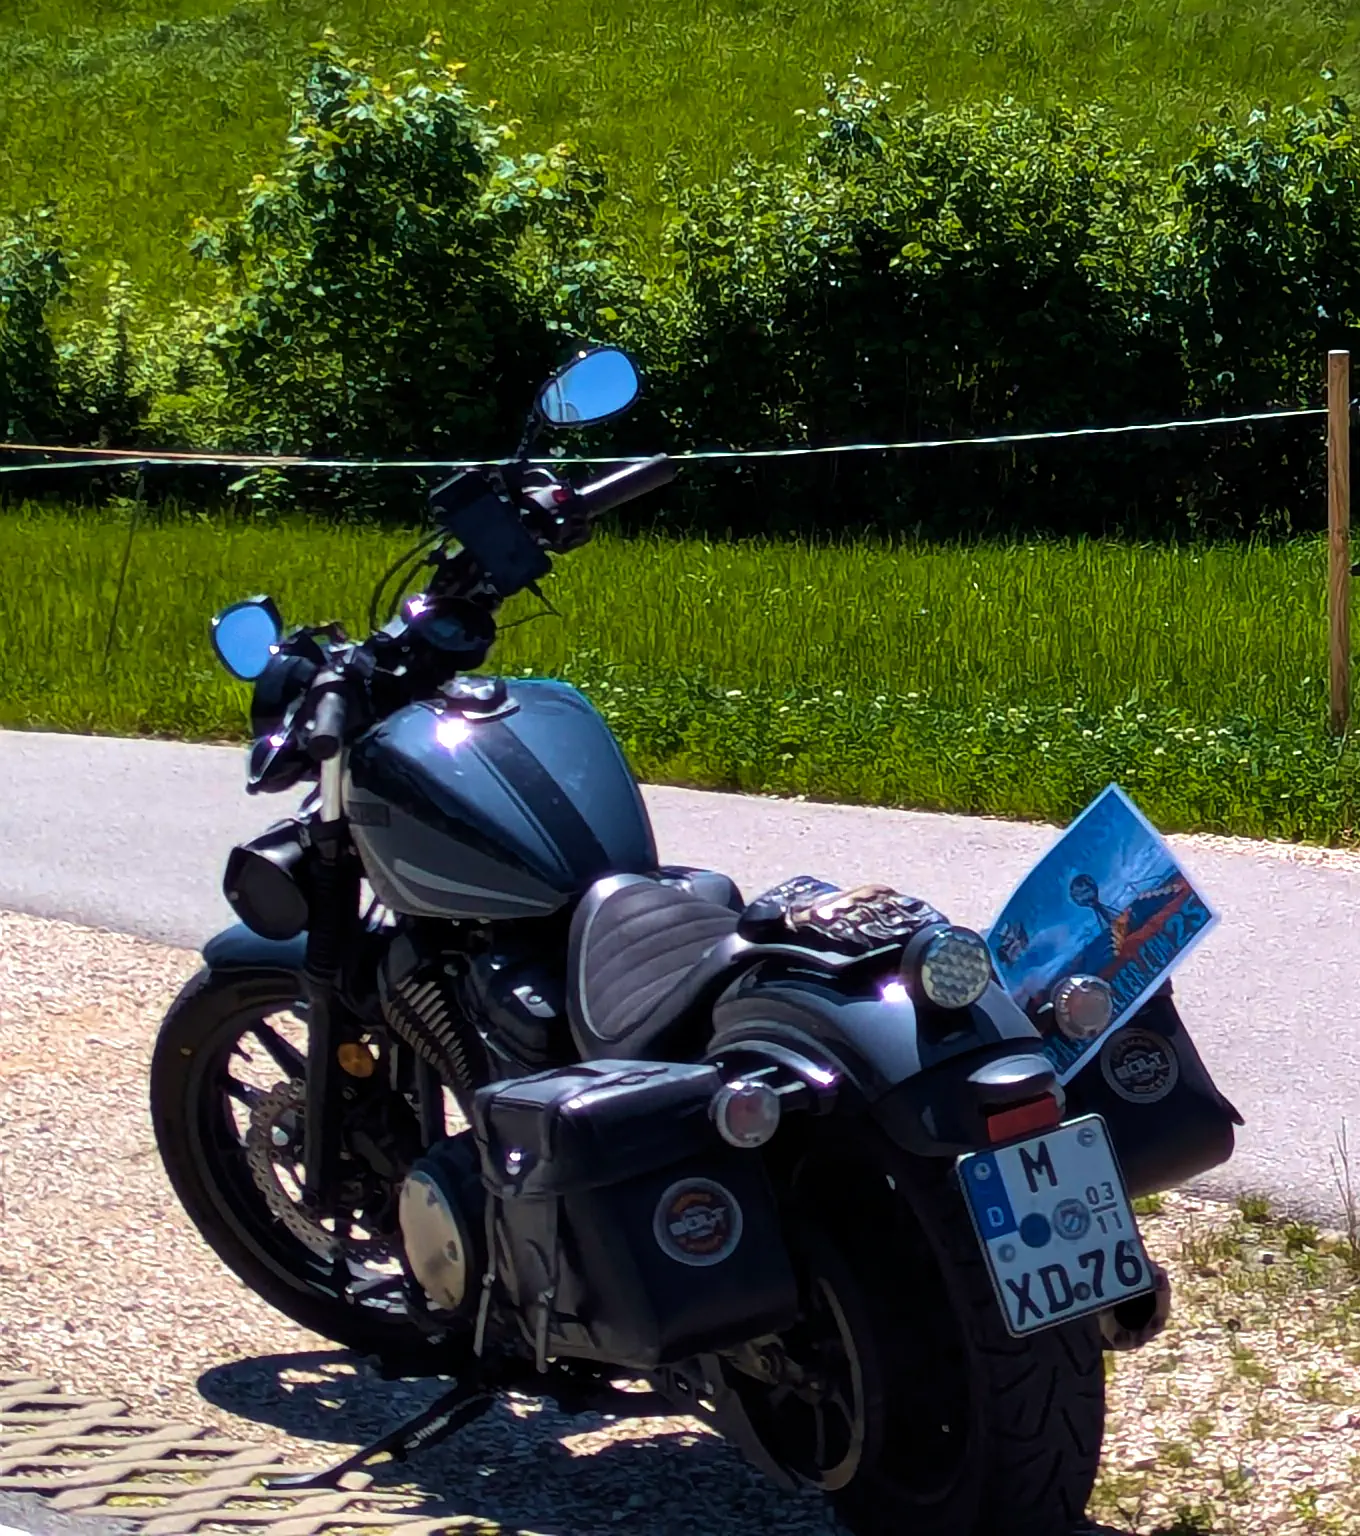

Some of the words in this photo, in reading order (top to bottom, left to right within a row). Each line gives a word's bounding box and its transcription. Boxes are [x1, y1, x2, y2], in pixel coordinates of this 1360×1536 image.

[1019, 1141, 1058, 1193] M
[1085, 1181, 1116, 1206] 03
[986, 1206, 1005, 1228] D
[1095, 1210, 1124, 1235] 11
